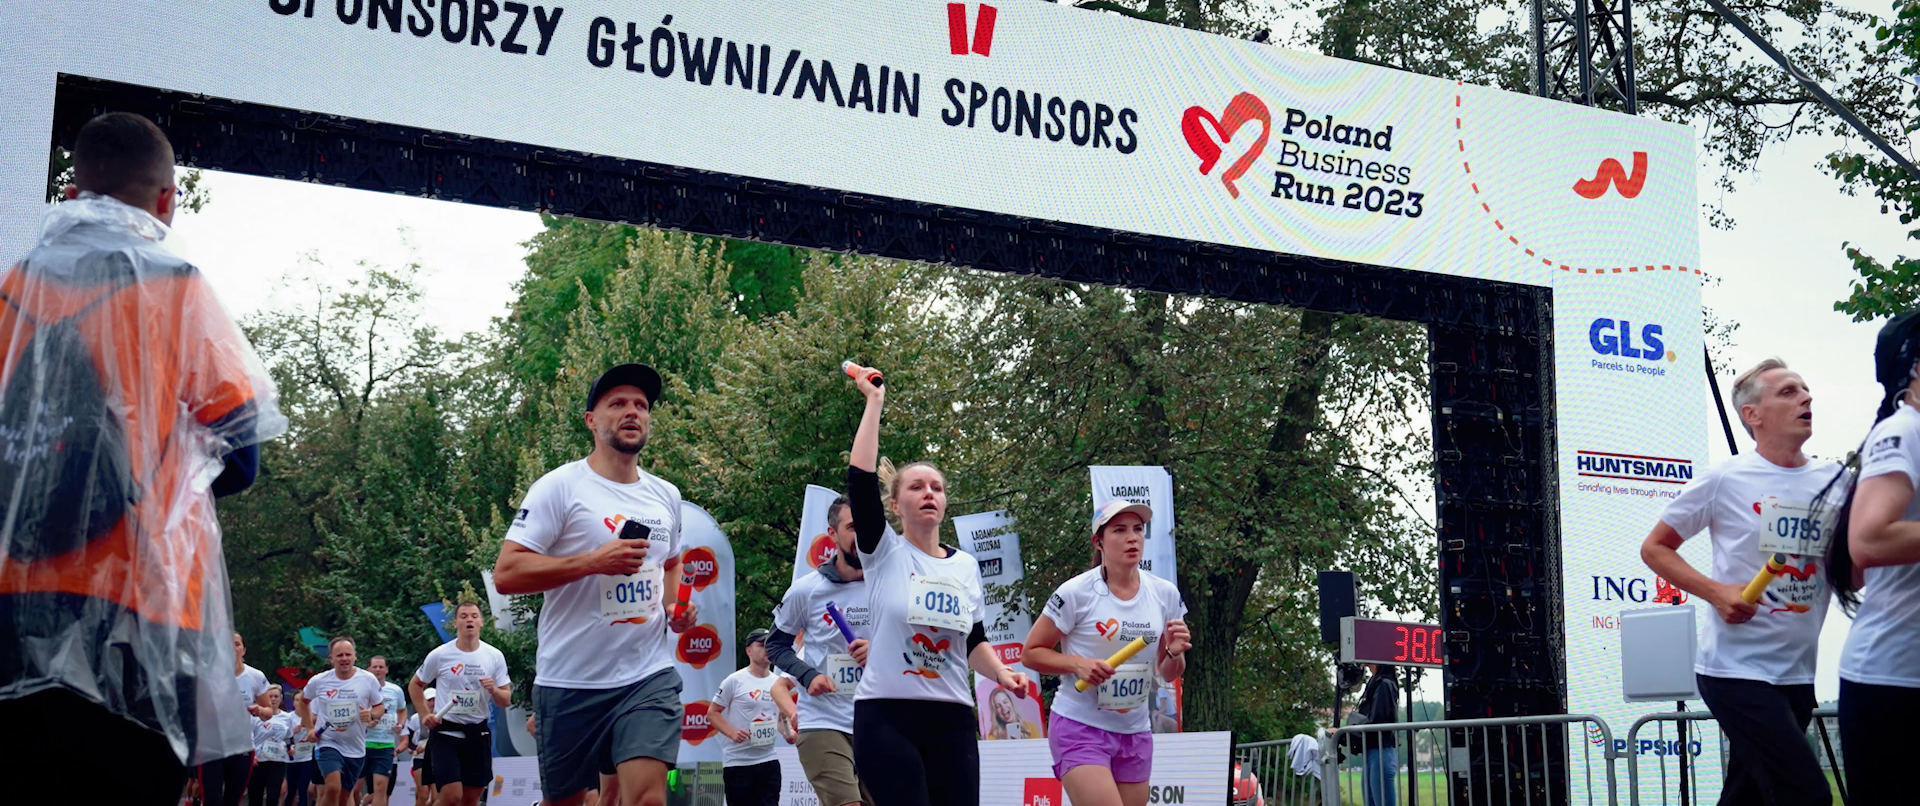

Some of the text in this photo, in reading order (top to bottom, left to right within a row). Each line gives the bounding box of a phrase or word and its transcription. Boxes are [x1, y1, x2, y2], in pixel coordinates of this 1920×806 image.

[941, 78, 1138, 154] SPONSORS
[1283, 108, 1393, 152] Poland
[1277, 141, 1411, 186] Business
[1270, 171, 1425, 219] Run 2023
[1592, 359, 1666, 377] Parcels to People
[1577, 455, 1693, 480] HUNTSMAN
[1613, 485, 1629, 495] lives
[1630, 487, 1658, 498] through
[615, 580, 652, 604] 0145
[1591, 575, 1648, 603] ING
[925, 591, 961, 616] 0138
[1121, 621, 1151, 629] Poland
[1592, 615, 1613, 629] ING
[1120, 628, 1156, 636] Business
[839, 666, 863, 684] 150
[1111, 678, 1144, 697] 1601
[789, 781, 816, 793] BUSIN
[1163, 785, 1185, 804] ON
[790, 797, 818, 806] INSIDE
